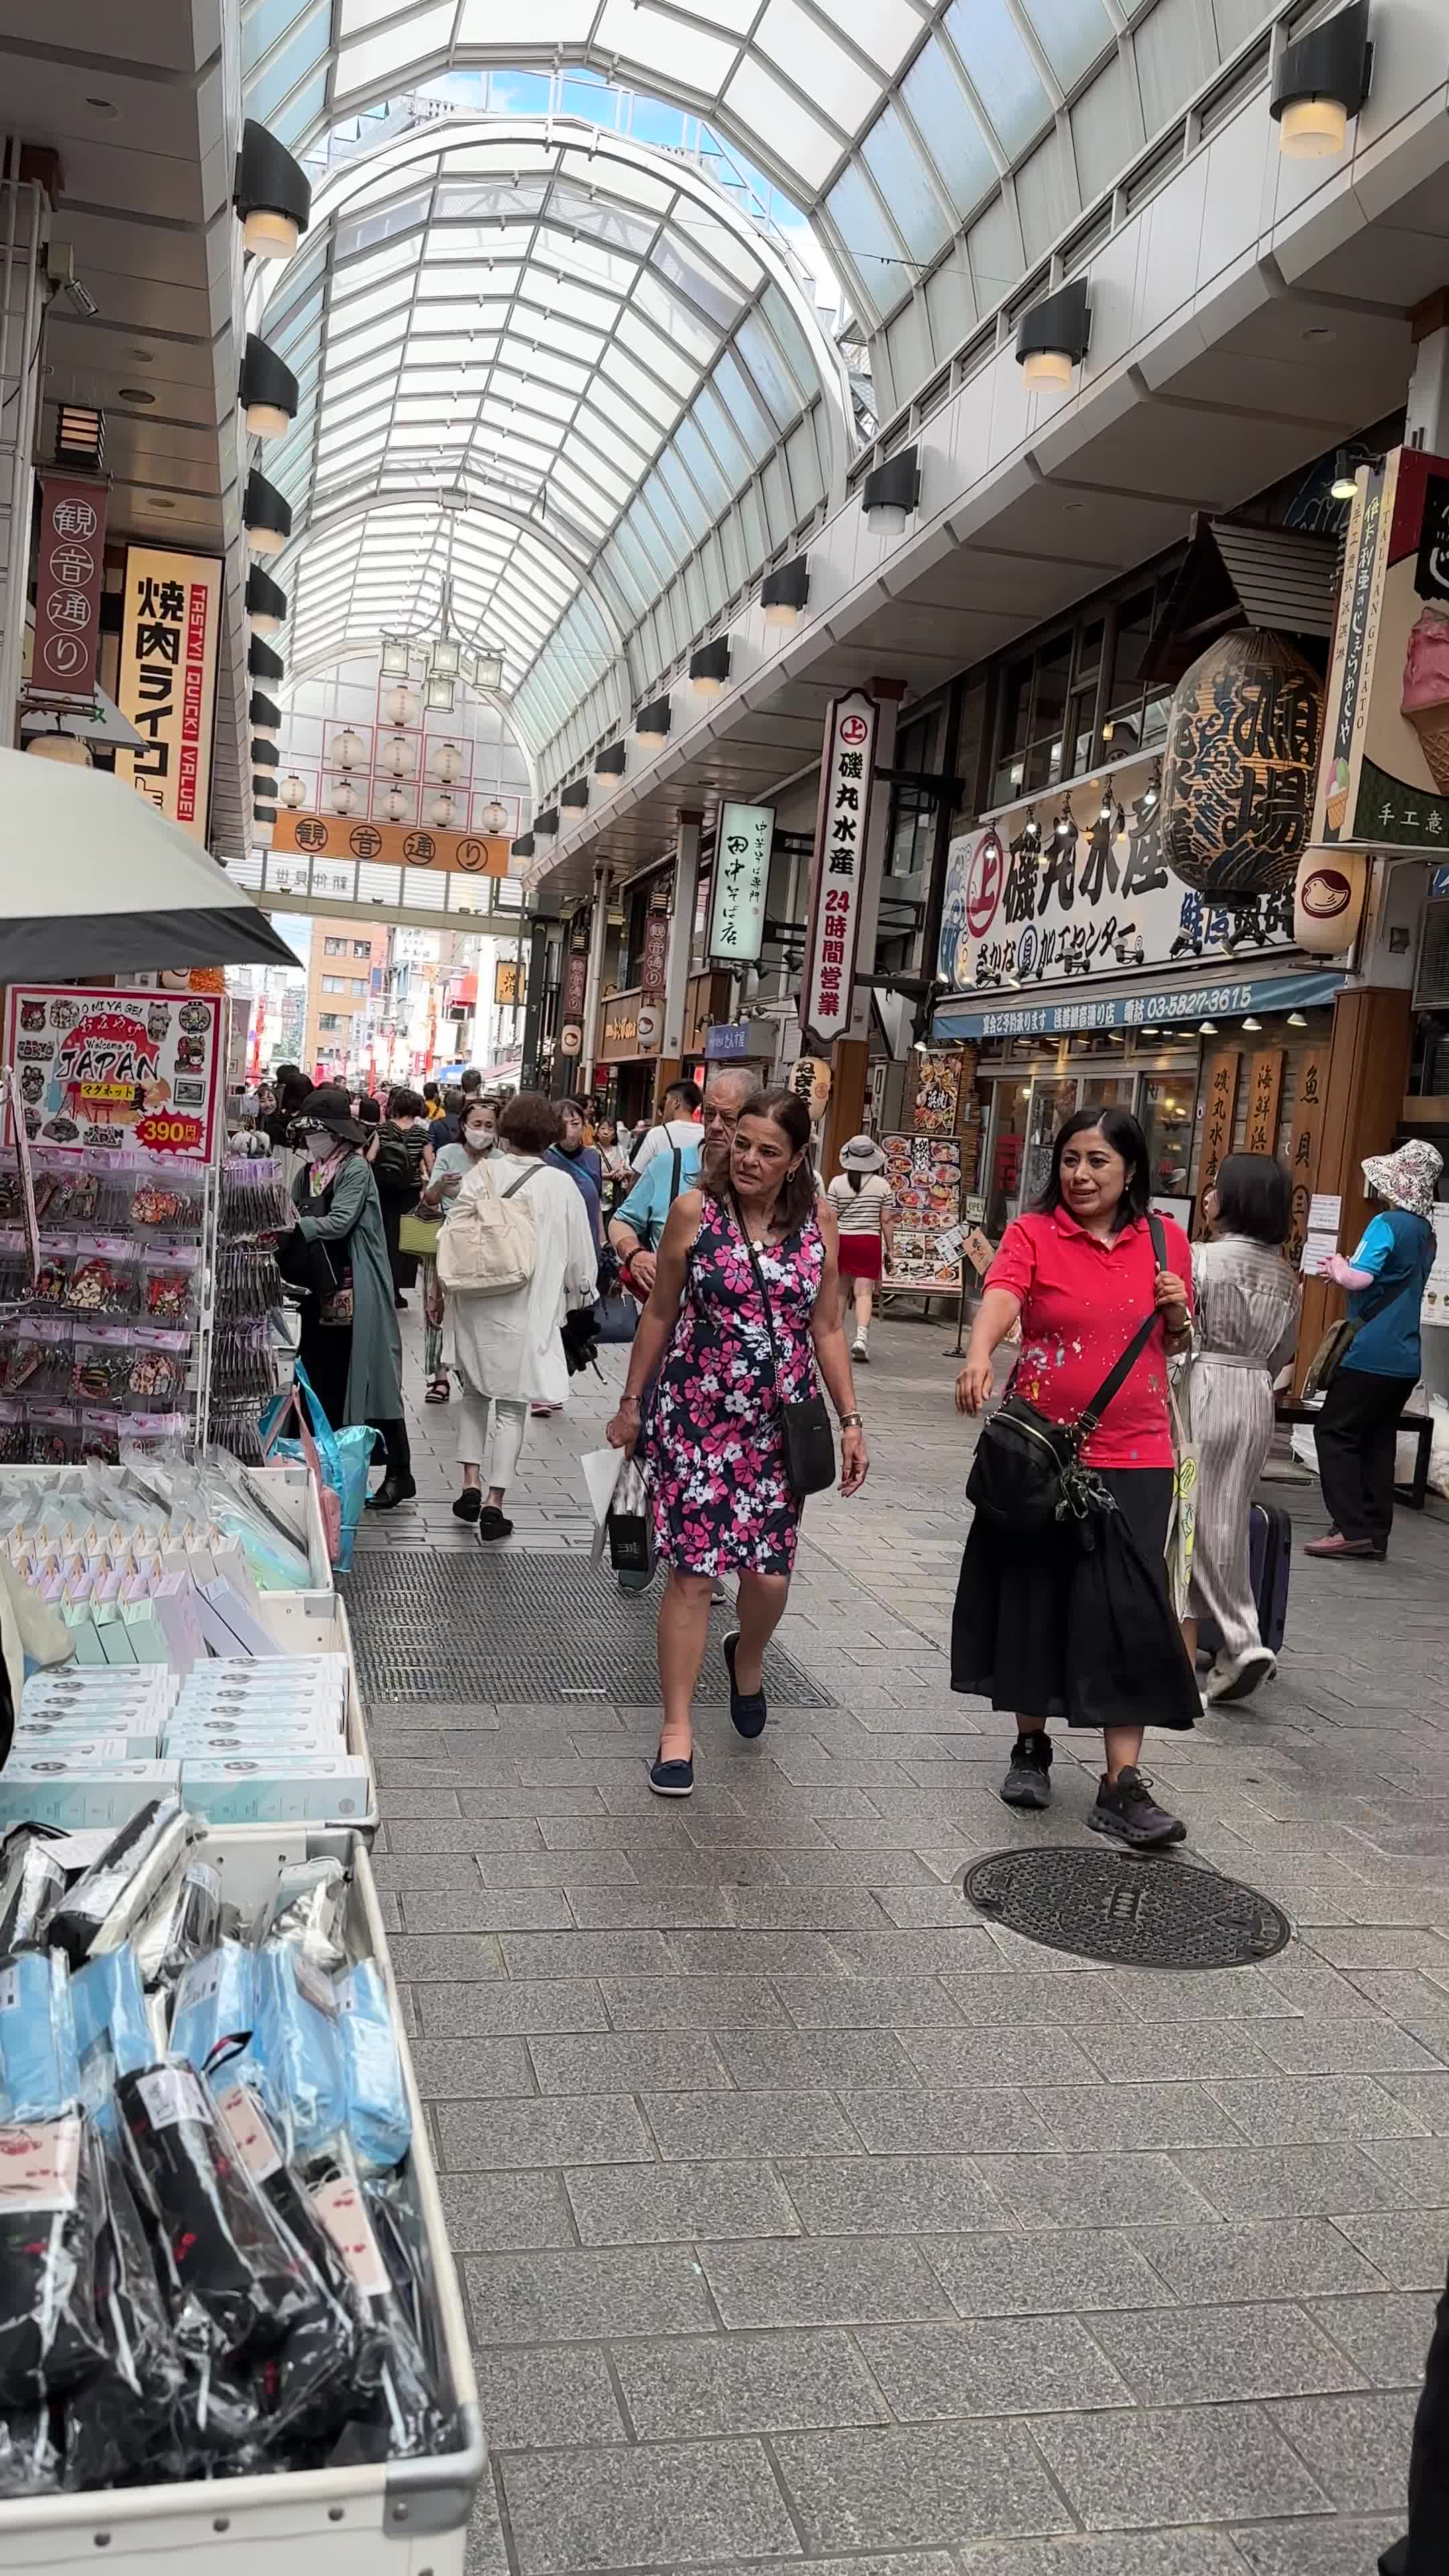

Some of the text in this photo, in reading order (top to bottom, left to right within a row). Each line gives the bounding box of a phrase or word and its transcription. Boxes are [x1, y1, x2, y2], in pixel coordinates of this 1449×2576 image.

[44, 498, 97, 677] 観音通り
[1356, 492, 1391, 730] ITALIAN GELATO
[134, 576, 184, 777] 焼肉ライク
[177, 584, 207, 820] TASTY! QUICK! VALUE!
[828, 751, 863, 875] 磯丸水産
[1378, 802, 1443, 834] 手工意
[295, 818, 488, 871] 観音通り
[720, 836, 749, 945] 田中そば店
[818, 889, 851, 1017] 24時間営業
[78, 1013, 145, 1037] おみやげ
[1147, 985, 1252, 1020] 03-5827-3615
[55, 1049, 160, 1081] JAPAN
[86, 1039, 135, 1051] Welcome to
[82, 1084, 133, 1099] マグネット
[143, 1121, 197, 1142] 390円
